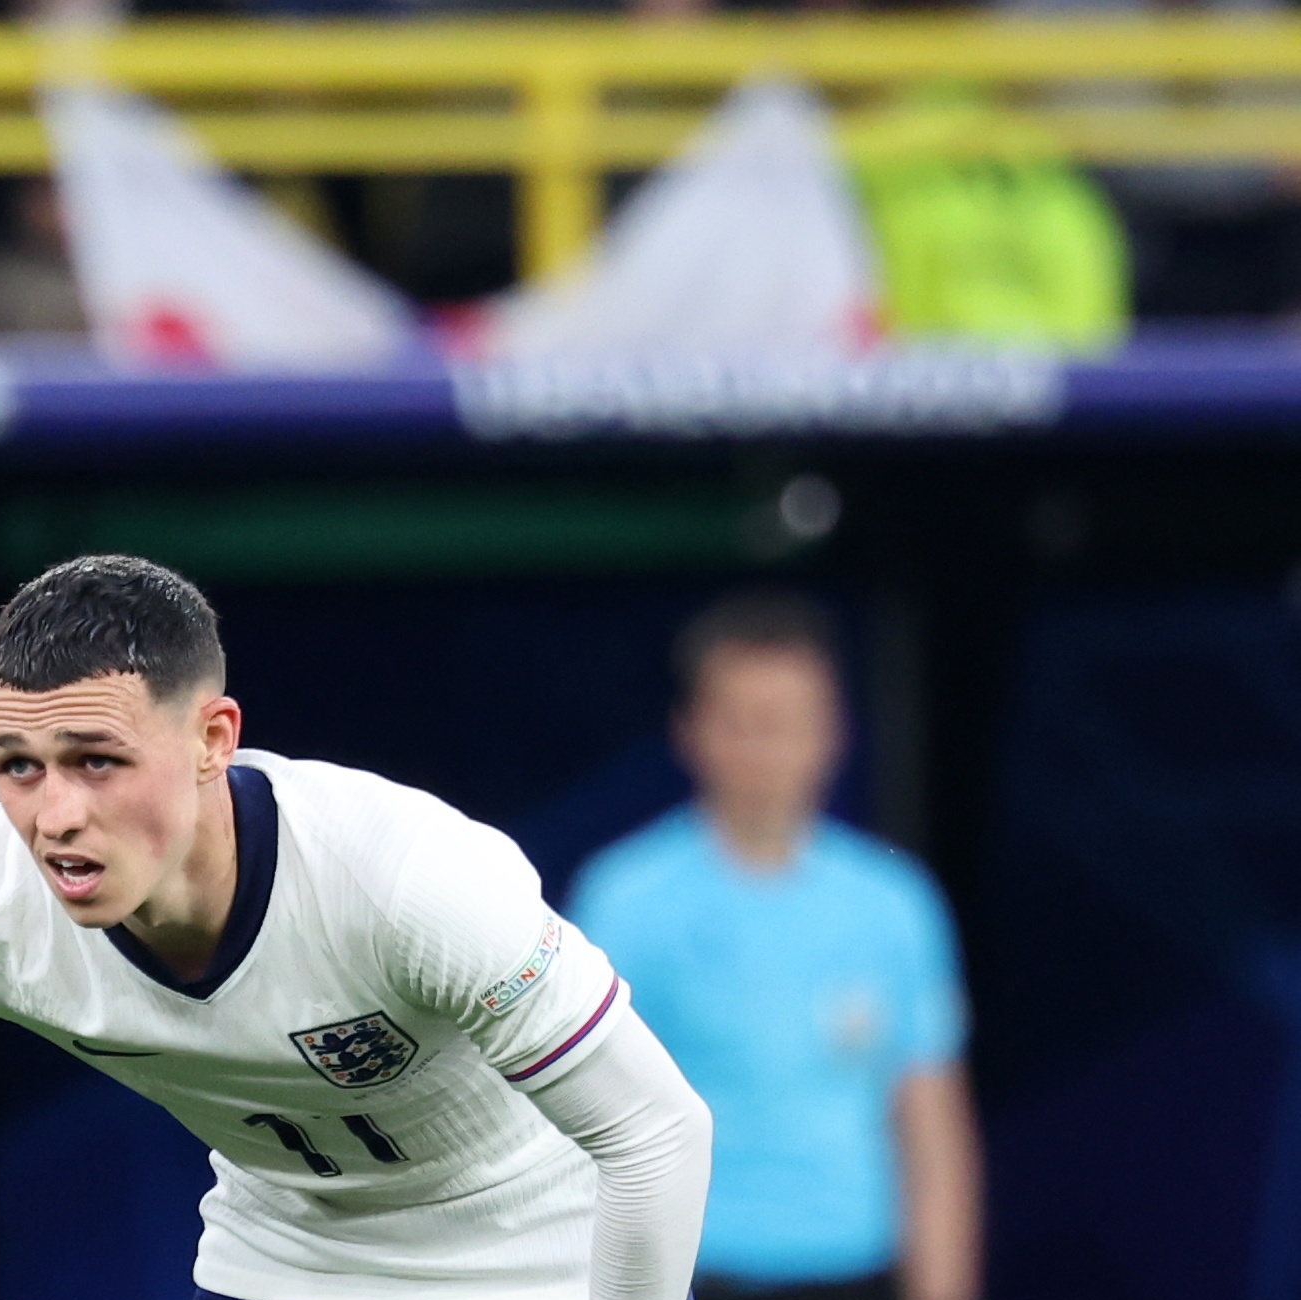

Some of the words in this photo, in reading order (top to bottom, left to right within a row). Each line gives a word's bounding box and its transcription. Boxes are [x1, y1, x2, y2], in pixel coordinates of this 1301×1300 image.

[480, 980, 508, 1001] UEFA
[485, 914, 556, 1010] FOUNDATION
[242, 1113, 411, 1178] 11
